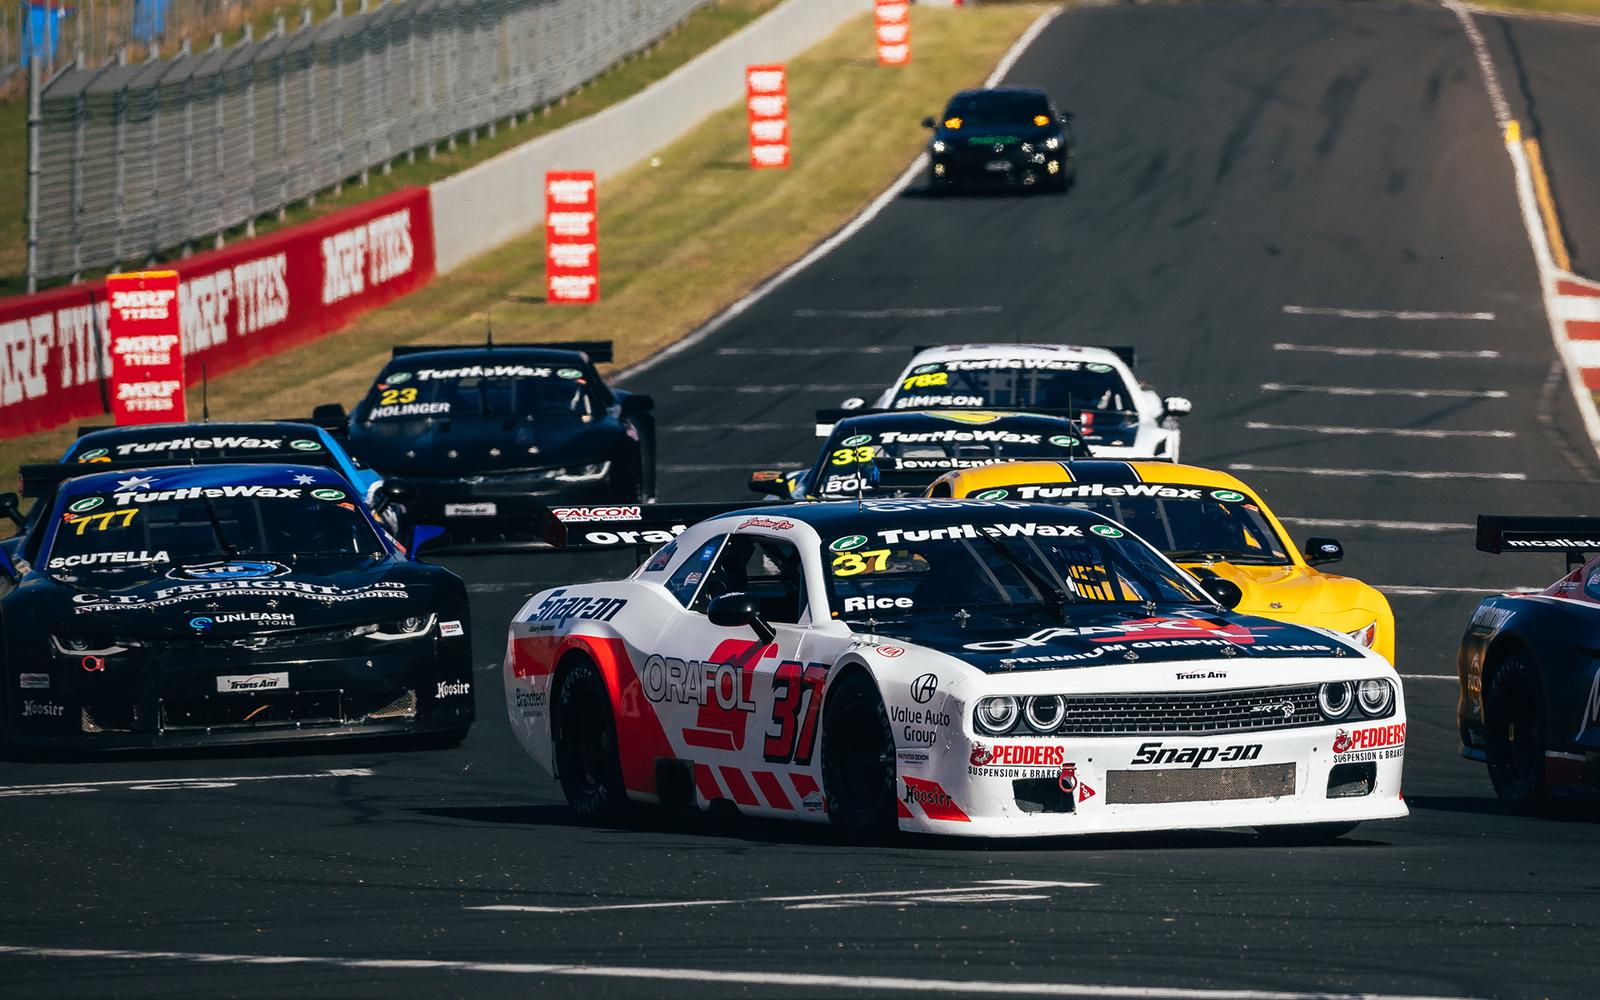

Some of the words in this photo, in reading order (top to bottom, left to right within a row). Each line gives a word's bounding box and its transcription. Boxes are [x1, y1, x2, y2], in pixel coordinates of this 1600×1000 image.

[321, 226, 367, 305] MRF
[367, 208, 414, 286] TYRES
[111, 289, 176, 309] MRF
[178, 269, 233, 356] MRF
[233, 251, 289, 337] TYRES
[119, 307, 169, 321] TYRES
[114, 335, 178, 354] MRF
[0, 311, 54, 407] RF
[122, 352, 171, 367] TYRES
[116, 380, 181, 400] MRF
[904, 372, 948, 390] 782
[379, 387, 418, 406] 23
[896, 394, 984, 408] SIMPSON
[368, 401, 451, 421] HOLINGER
[832, 446, 875, 466] 33
[113, 485, 302, 505] TurtleWax
[1017, 483, 1202, 499] TurtleWax
[70, 507, 139, 536] 777
[551, 506, 641, 518] FALCON
[877, 523, 1084, 544] TurtleWax
[1506, 538, 1600, 547] mcalist
[50, 551, 170, 569] SCUTELLA
[832, 549, 891, 577] 37
[154, 580, 341, 599] FREIGHT
[526, 589, 628, 629] Snap-on
[844, 595, 914, 613] Rice
[215, 612, 295, 624] UNLEASH
[1000, 643, 1128, 665] PREMIUM
[229, 681, 259, 690] Trans
[259, 680, 278, 688] Am
[642, 653, 756, 713] ORAFOL
[1176, 672, 1206, 681] Trans
[1207, 671, 1228, 680] Am
[434, 679, 471, 699] Hoosier
[22, 700, 64, 716] Hoosier
[763, 659, 832, 767] 37
[890, 705, 923, 725] Value
[923, 707, 952, 727] Auto
[903, 725, 937, 747] Group
[1351, 722, 1405, 750] PEDDERS
[991, 745, 1065, 766] PEDDERS
[1130, 742, 1263, 768] Snap-on
[1333, 750, 1377, 764] SUSPENSION
[967, 765, 1019, 778] SUSPENSION
[1021, 769, 1027, 778] &
[903, 783, 952, 808] Hoosier
[1080, 783, 1091, 799] TOW
